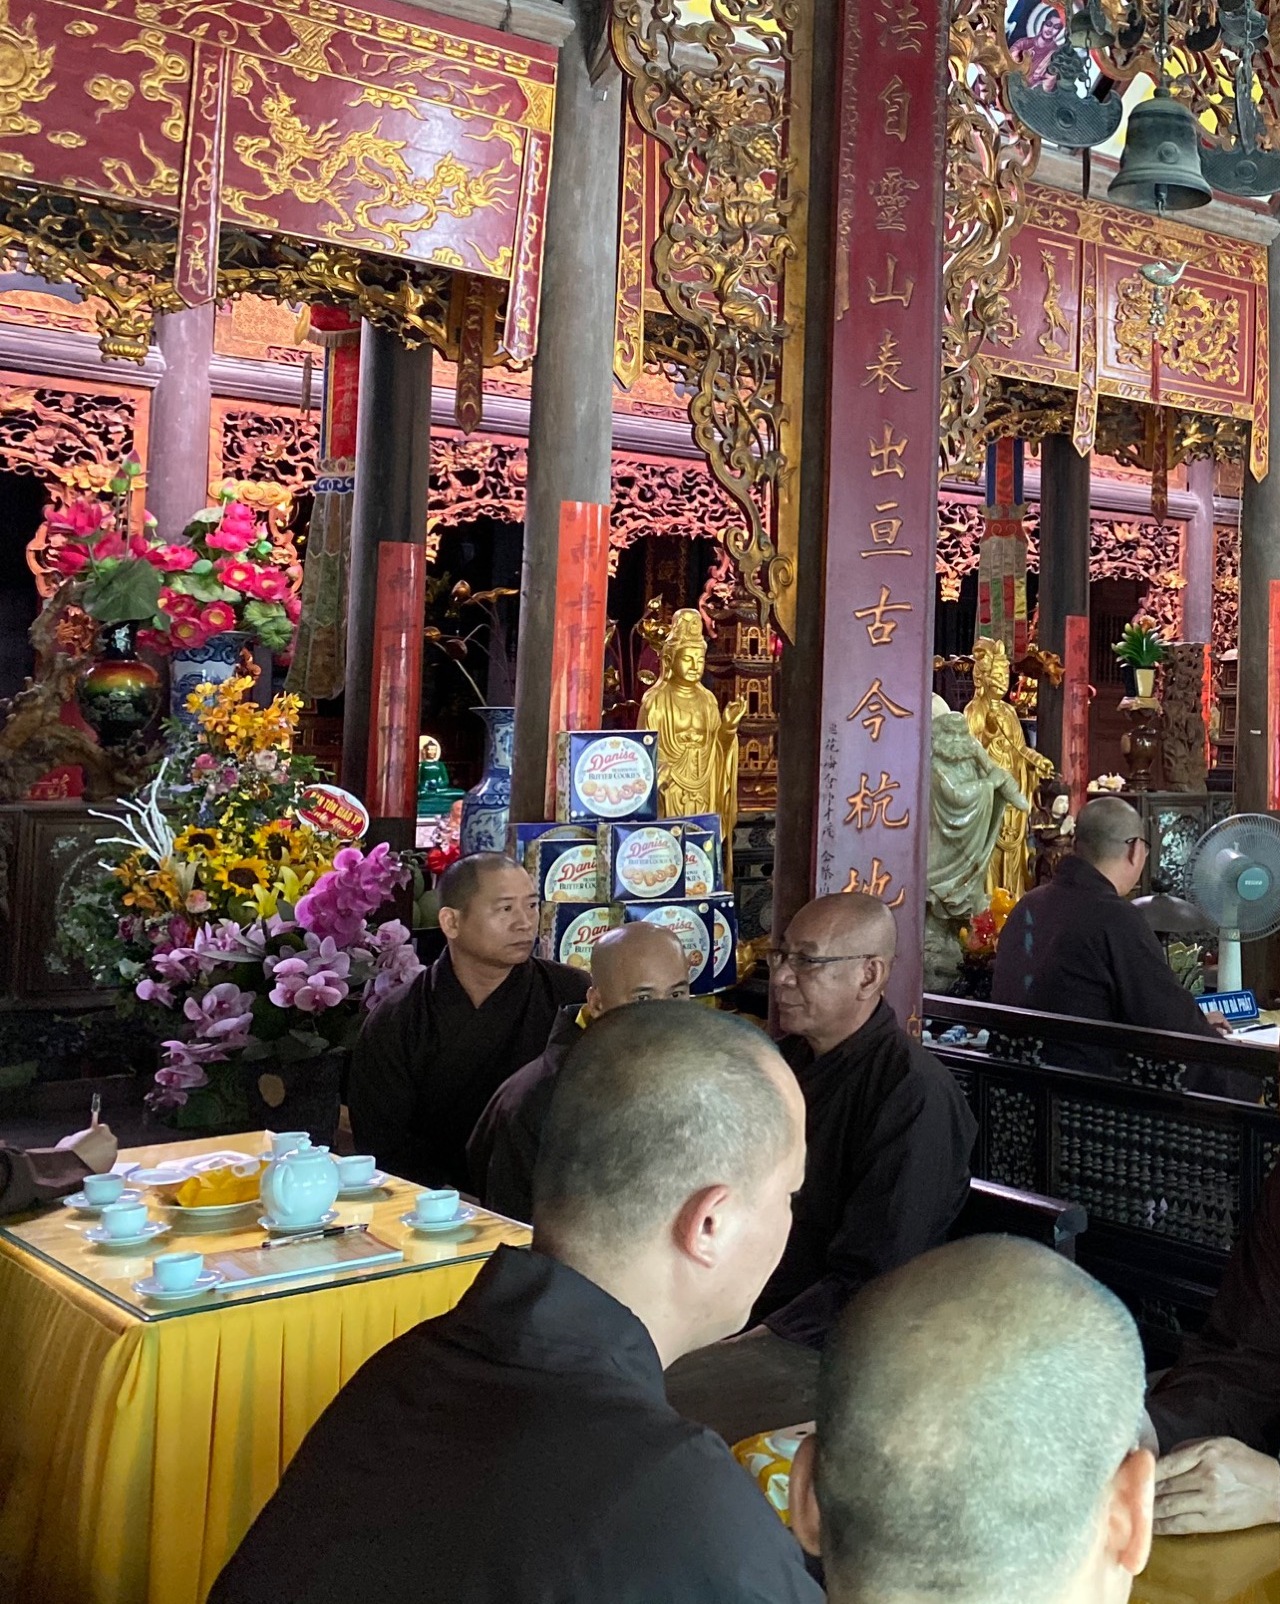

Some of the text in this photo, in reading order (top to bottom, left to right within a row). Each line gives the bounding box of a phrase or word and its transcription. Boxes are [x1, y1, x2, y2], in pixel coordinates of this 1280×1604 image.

[587, 748, 638, 772] Danisa
[626, 838, 671, 859] Danisa
[557, 857, 597, 882] Dani
